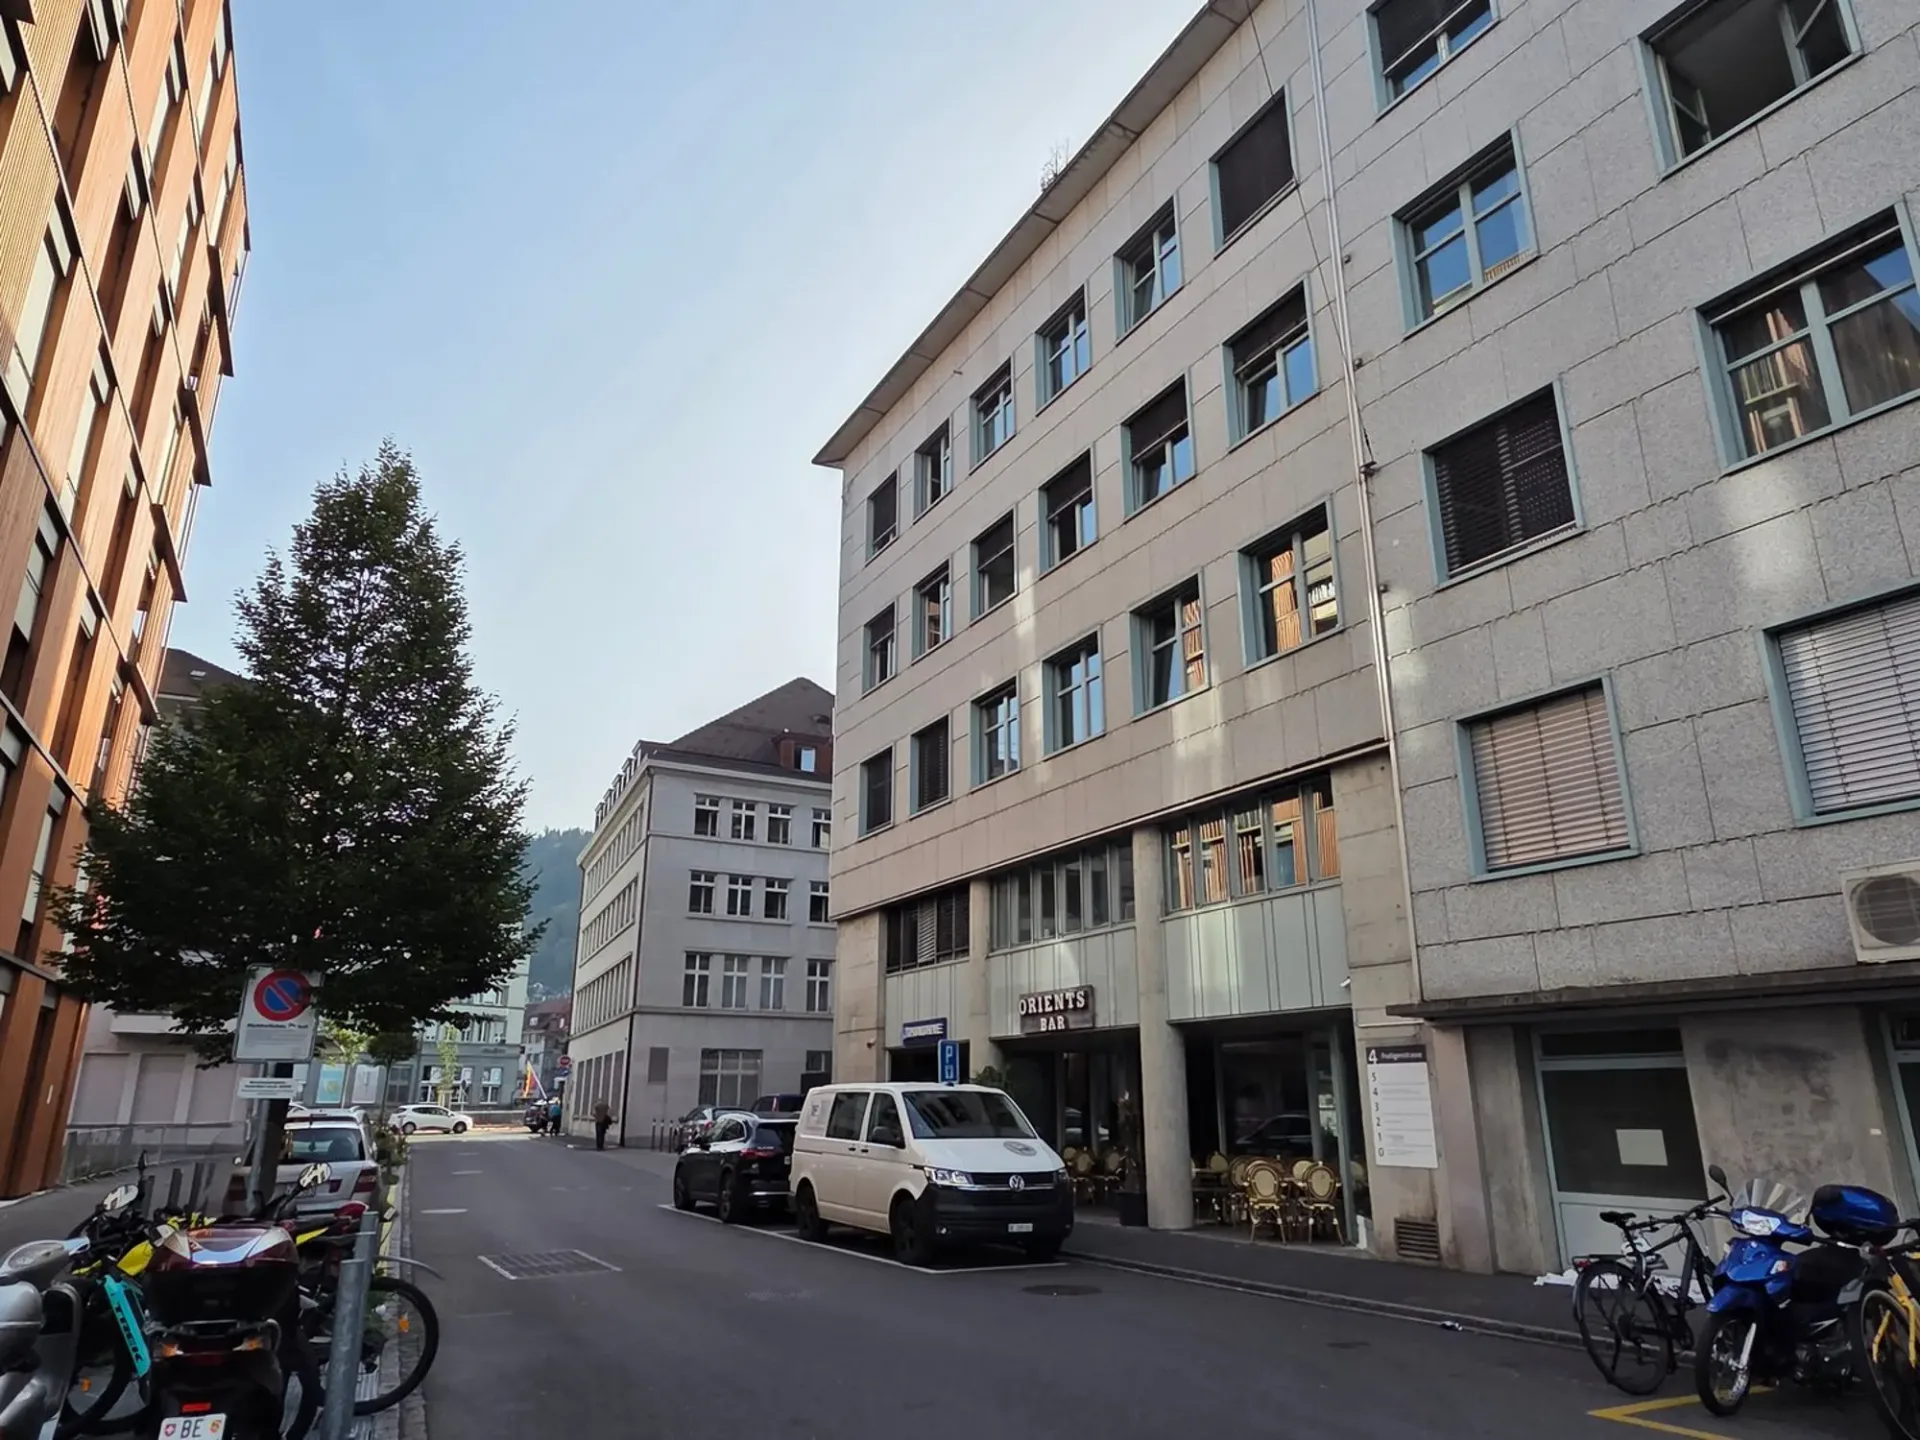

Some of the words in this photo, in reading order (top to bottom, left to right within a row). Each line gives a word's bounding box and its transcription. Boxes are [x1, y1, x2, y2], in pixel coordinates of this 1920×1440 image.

[1018, 990, 1086, 1016] ORIENTS
[1040, 1015, 1066, 1032] BAR
[945, 1045, 954, 1065] P
[1368, 1050, 1378, 1065] 4
[114, 1301, 144, 1362] TREK
[180, 1418, 204, 1439] BE
